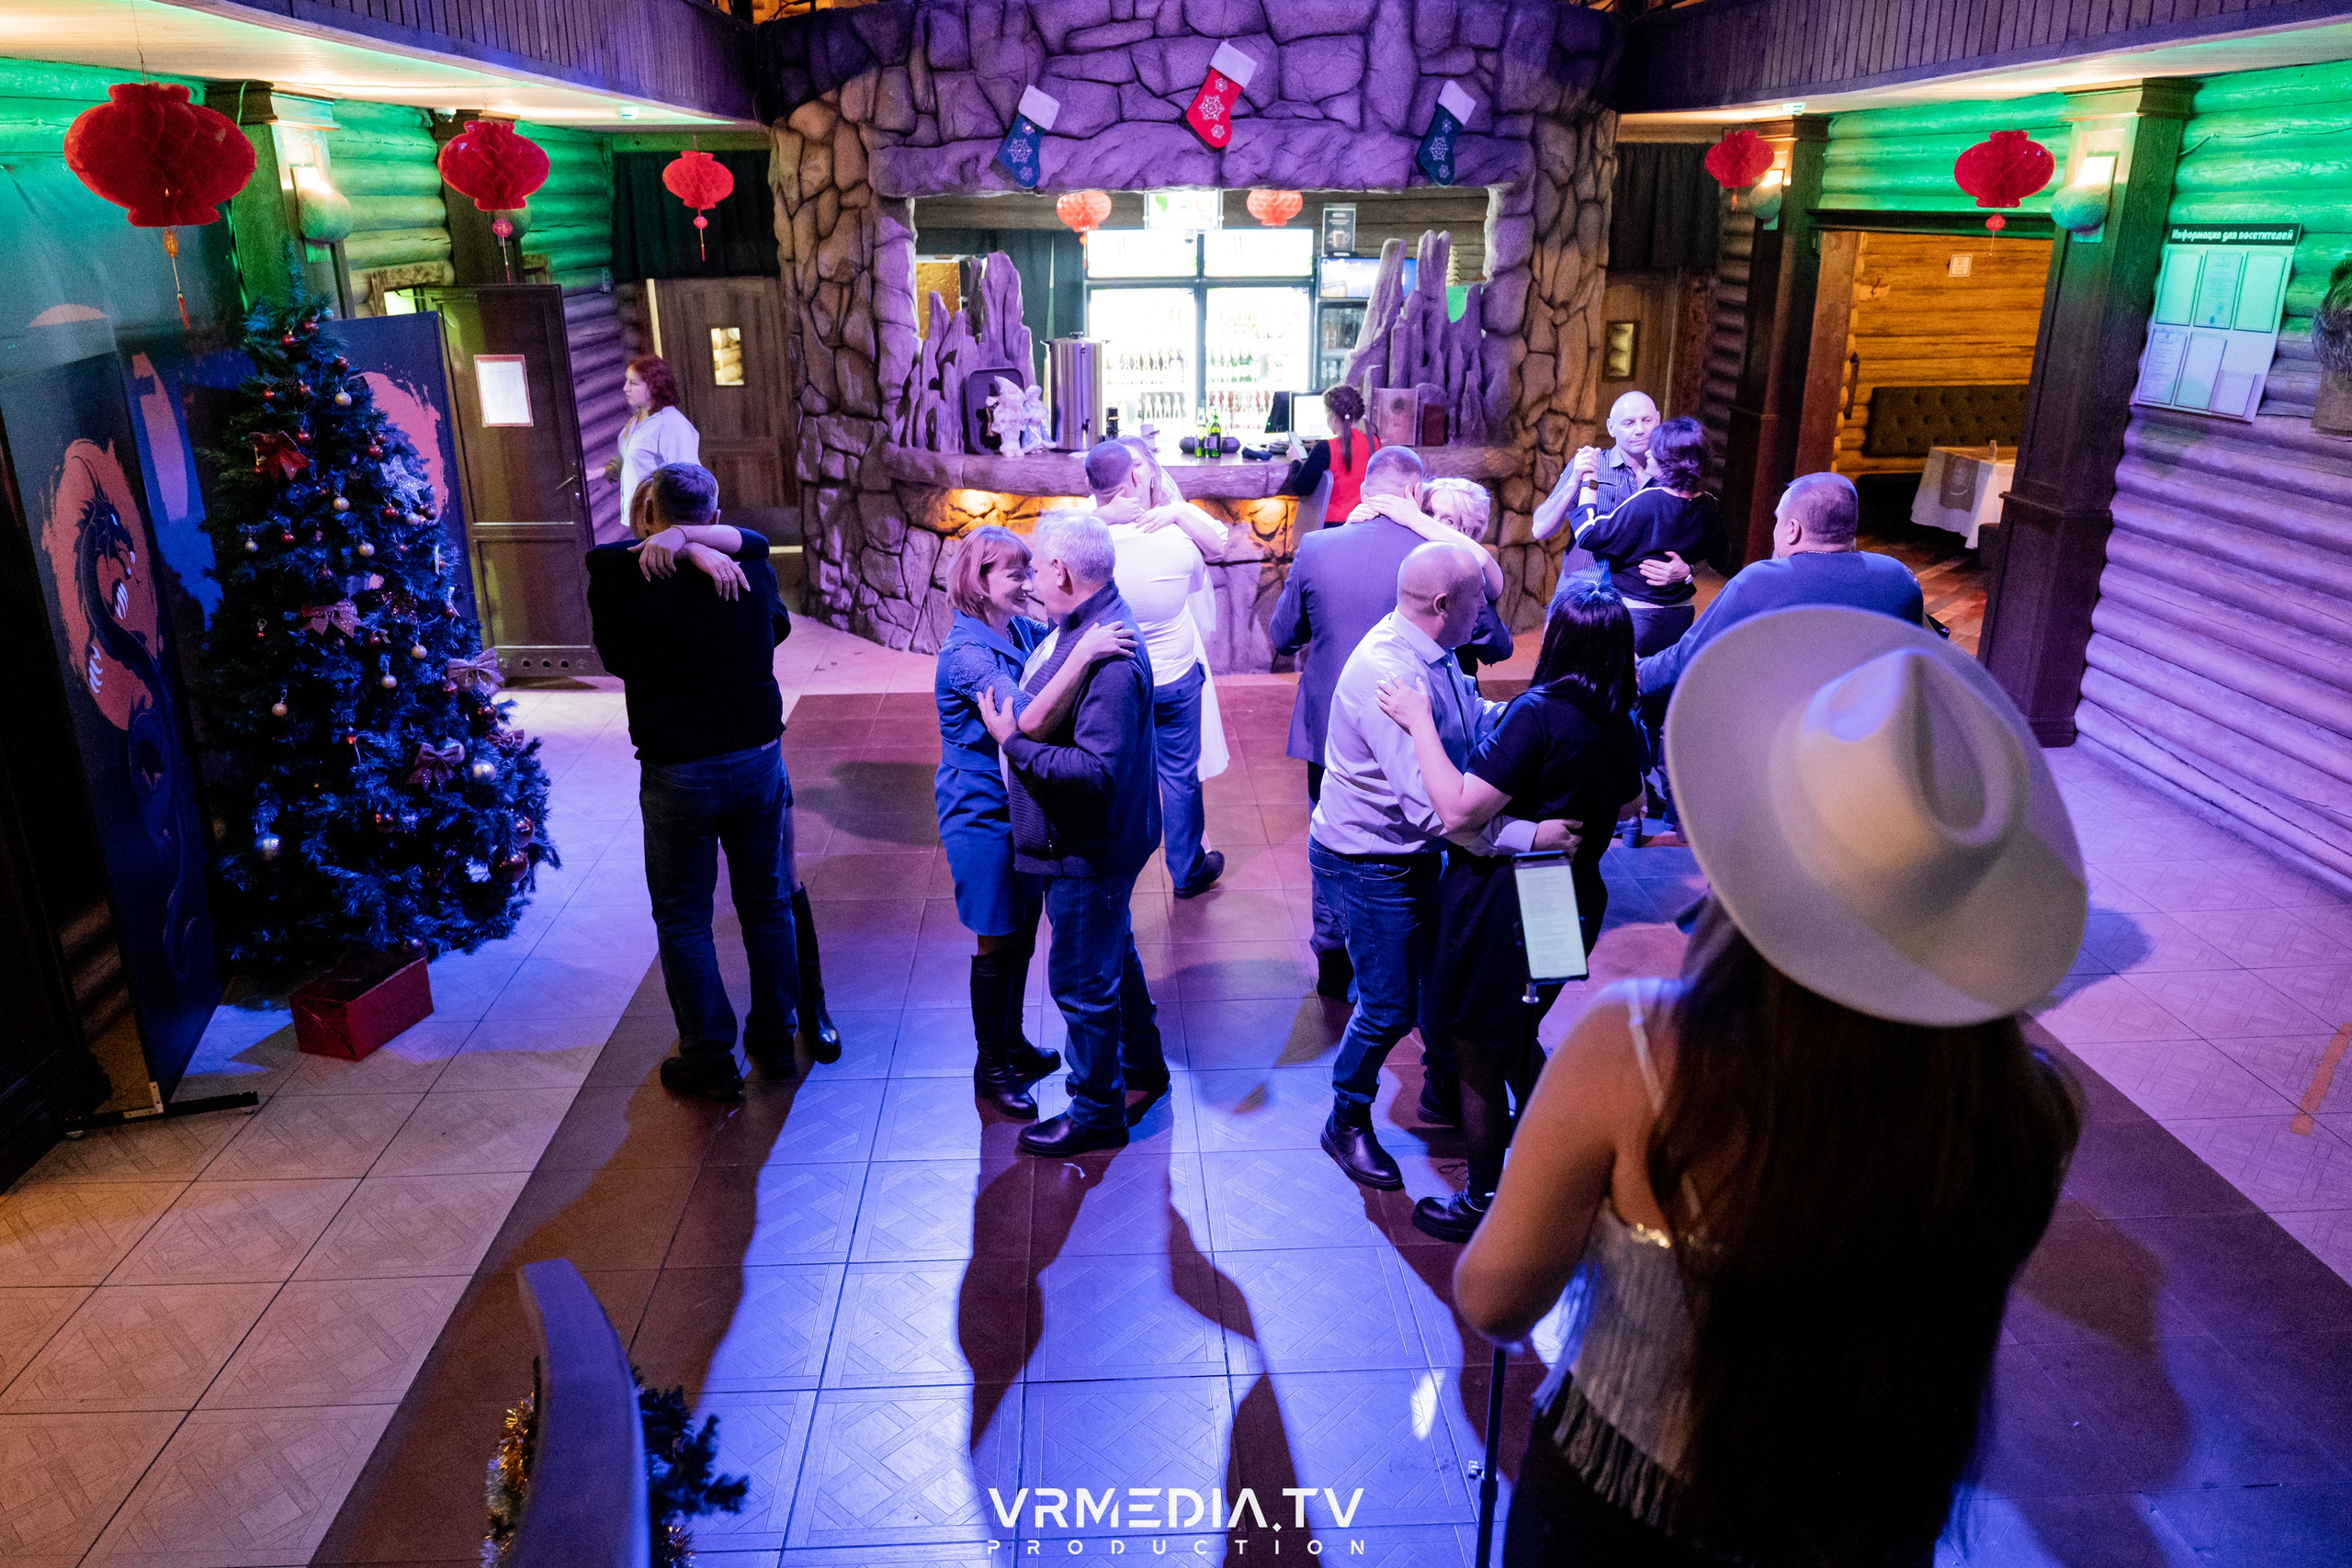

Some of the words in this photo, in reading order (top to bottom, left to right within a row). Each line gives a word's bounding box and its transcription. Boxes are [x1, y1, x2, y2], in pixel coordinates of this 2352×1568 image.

[2171, 229, 2222, 242] Информация
[2222, 231, 2237, 243] для
[2238, 229, 2294, 241] посетителей
